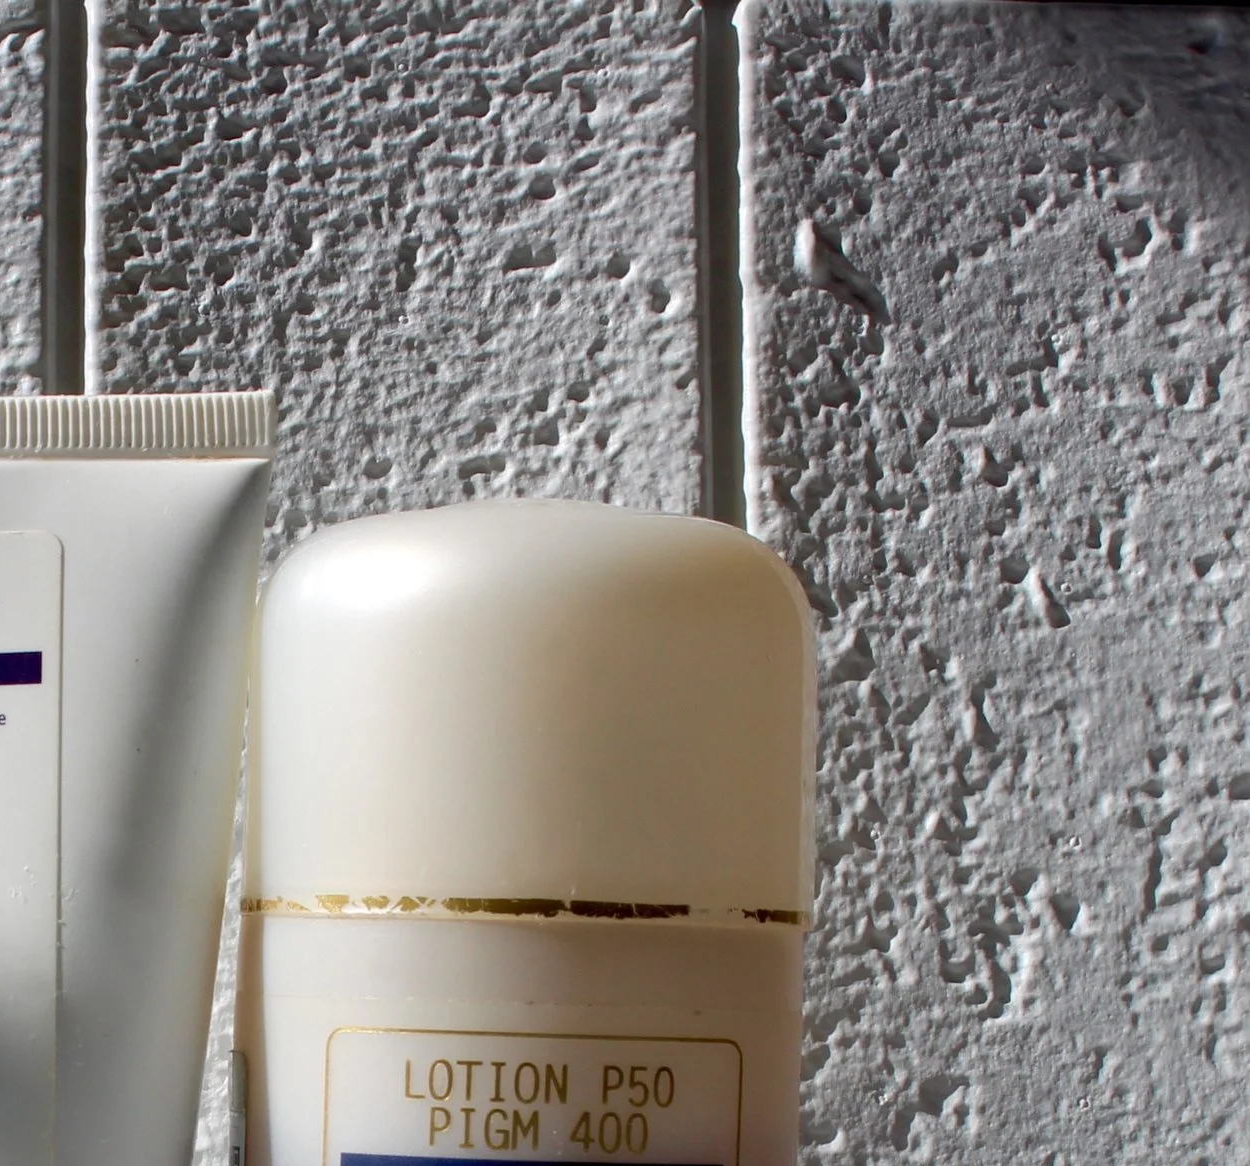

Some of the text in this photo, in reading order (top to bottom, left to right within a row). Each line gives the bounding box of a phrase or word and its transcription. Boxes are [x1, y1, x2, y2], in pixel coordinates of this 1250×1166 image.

[406, 1059, 674, 1108] LOTION P50
[430, 1107, 648, 1153] PIGM 400
